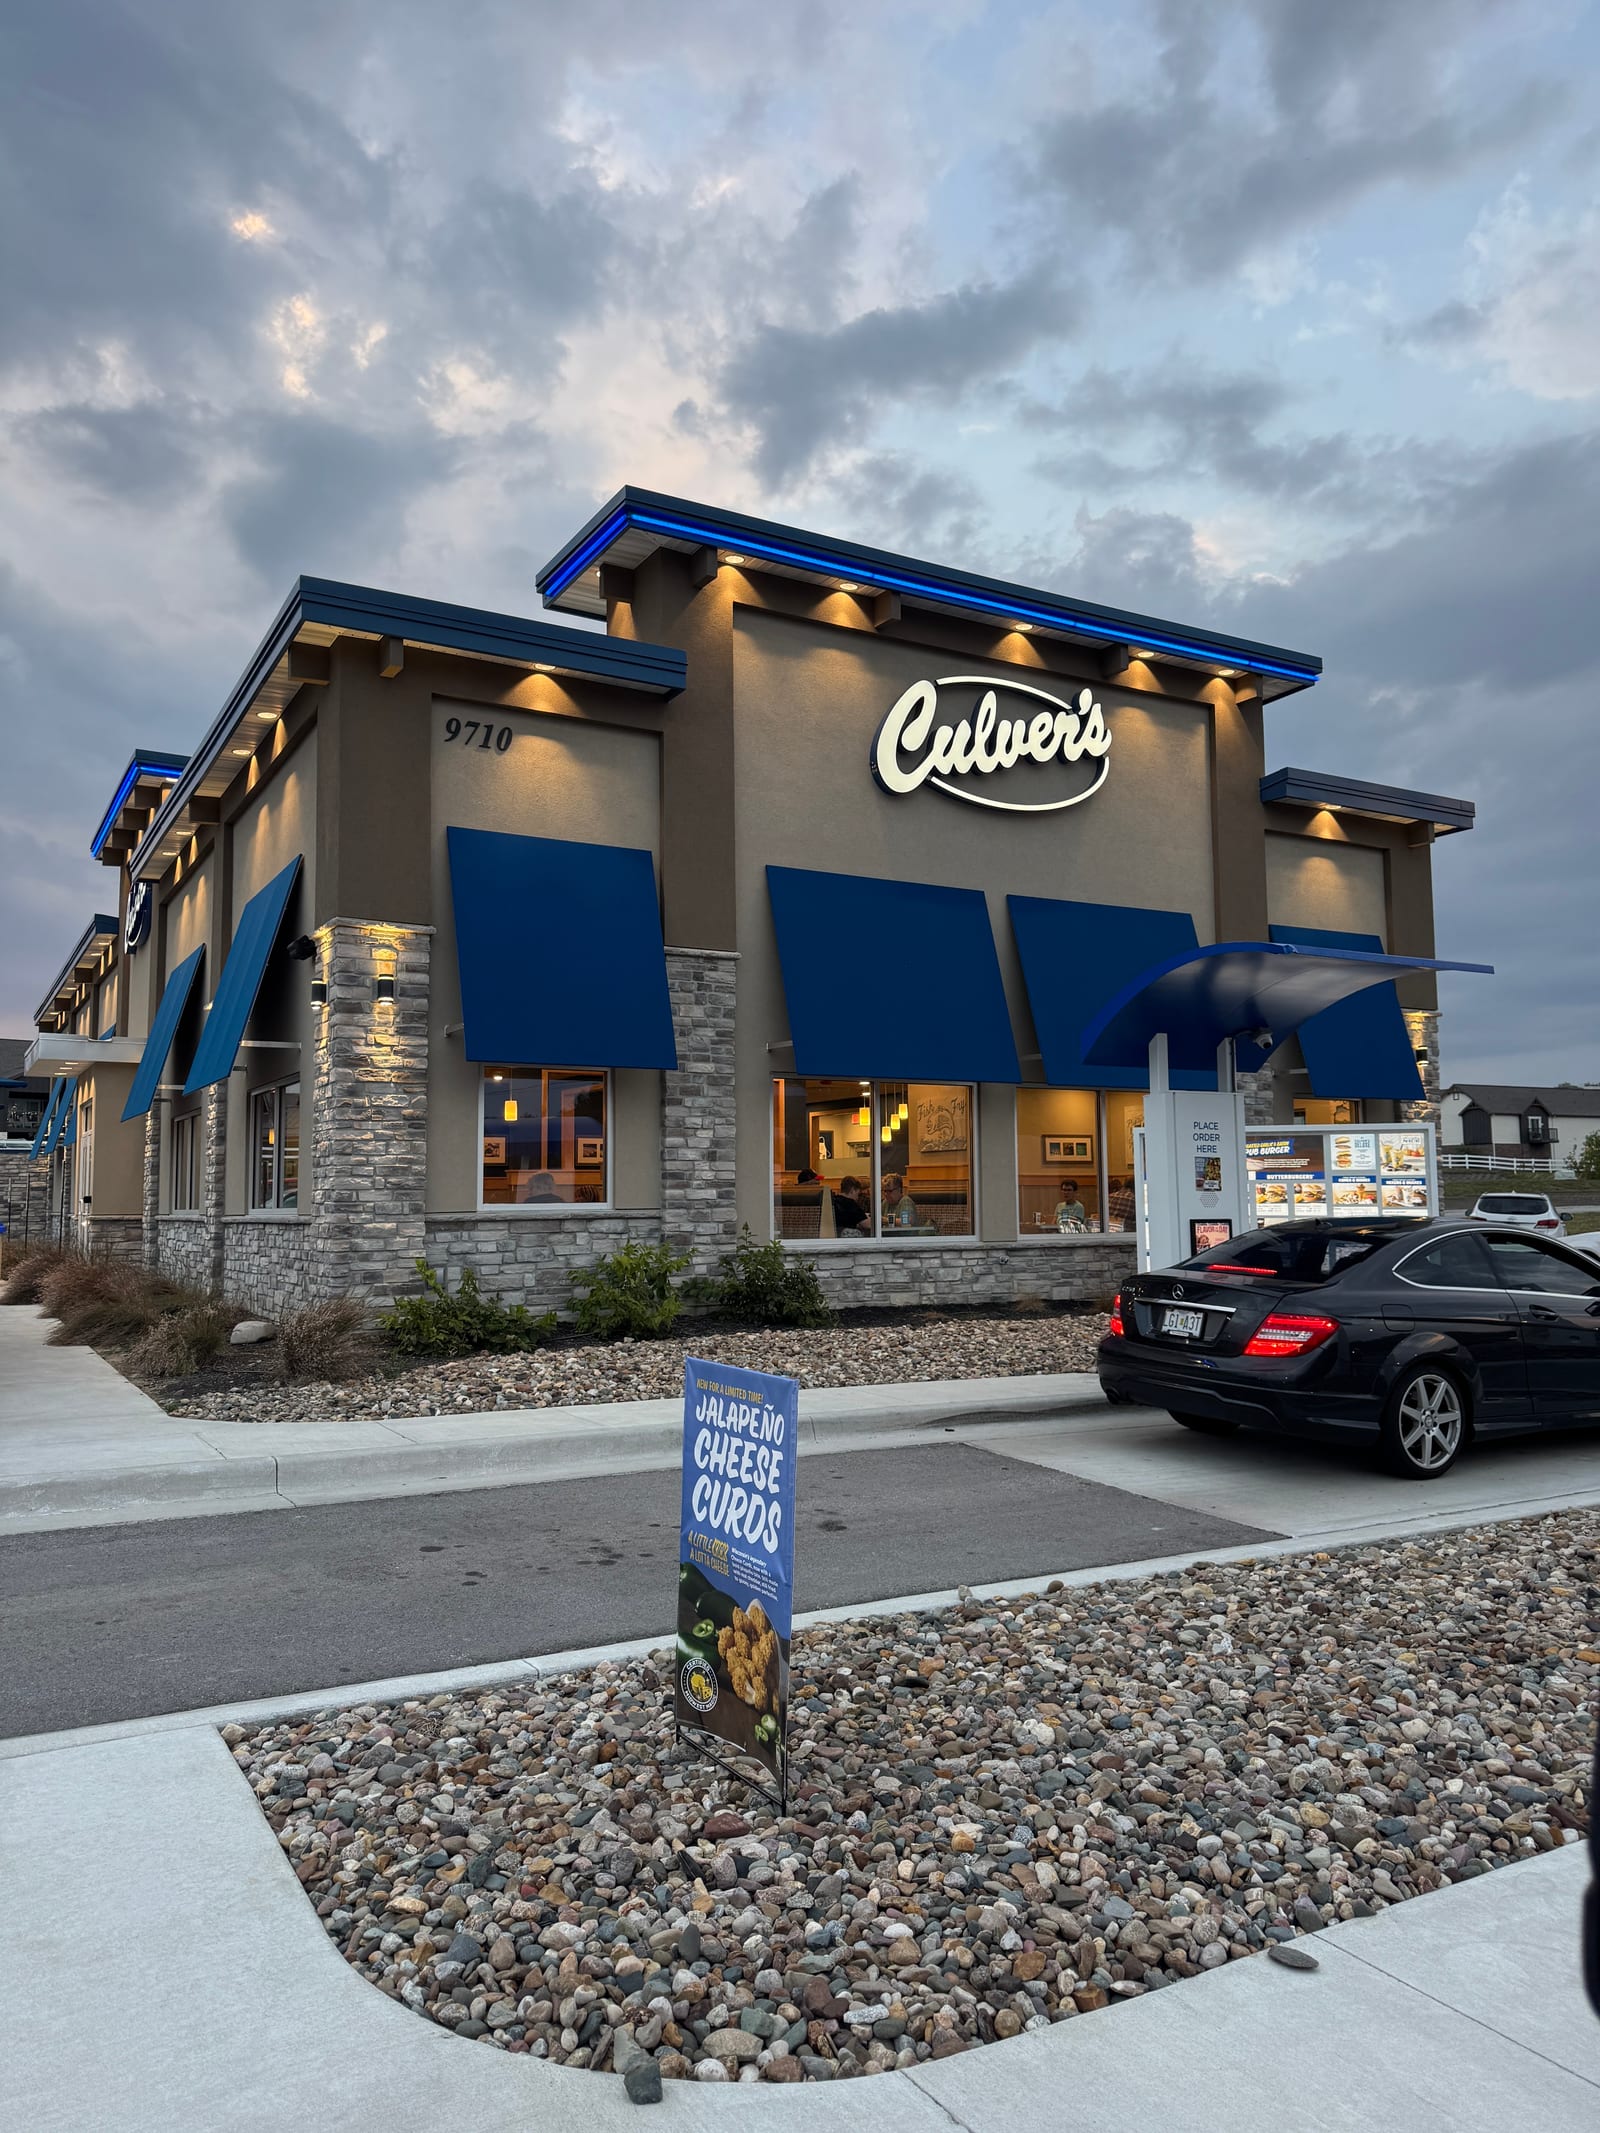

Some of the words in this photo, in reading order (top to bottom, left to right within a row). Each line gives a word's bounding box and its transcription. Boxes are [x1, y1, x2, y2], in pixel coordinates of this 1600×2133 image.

[443, 717, 513, 752] 9710
[876, 679, 1113, 794] Culver's
[1192, 1133, 1220, 1142] ORDER
[1193, 1121, 1219, 1130] PLACE
[1196, 1144, 1217, 1153] HERE
[1260, 1146, 1291, 1156] BURGER
[696, 1378, 708, 1390] NEW
[709, 1381, 719, 1393] FOR
[720, 1384, 725, 1395] A
[725, 1385, 747, 1400] LIMITED
[748, 1391, 764, 1404] TIME!
[695, 1394, 785, 1446] JALAPEÑO
[693, 1427, 784, 1494] CHEESE
[691, 1473, 783, 1554] CURDS
[688, 1530, 693, 1545] A
[693, 1532, 712, 1554] LITTLE
[689, 1547, 695, 1560] A
